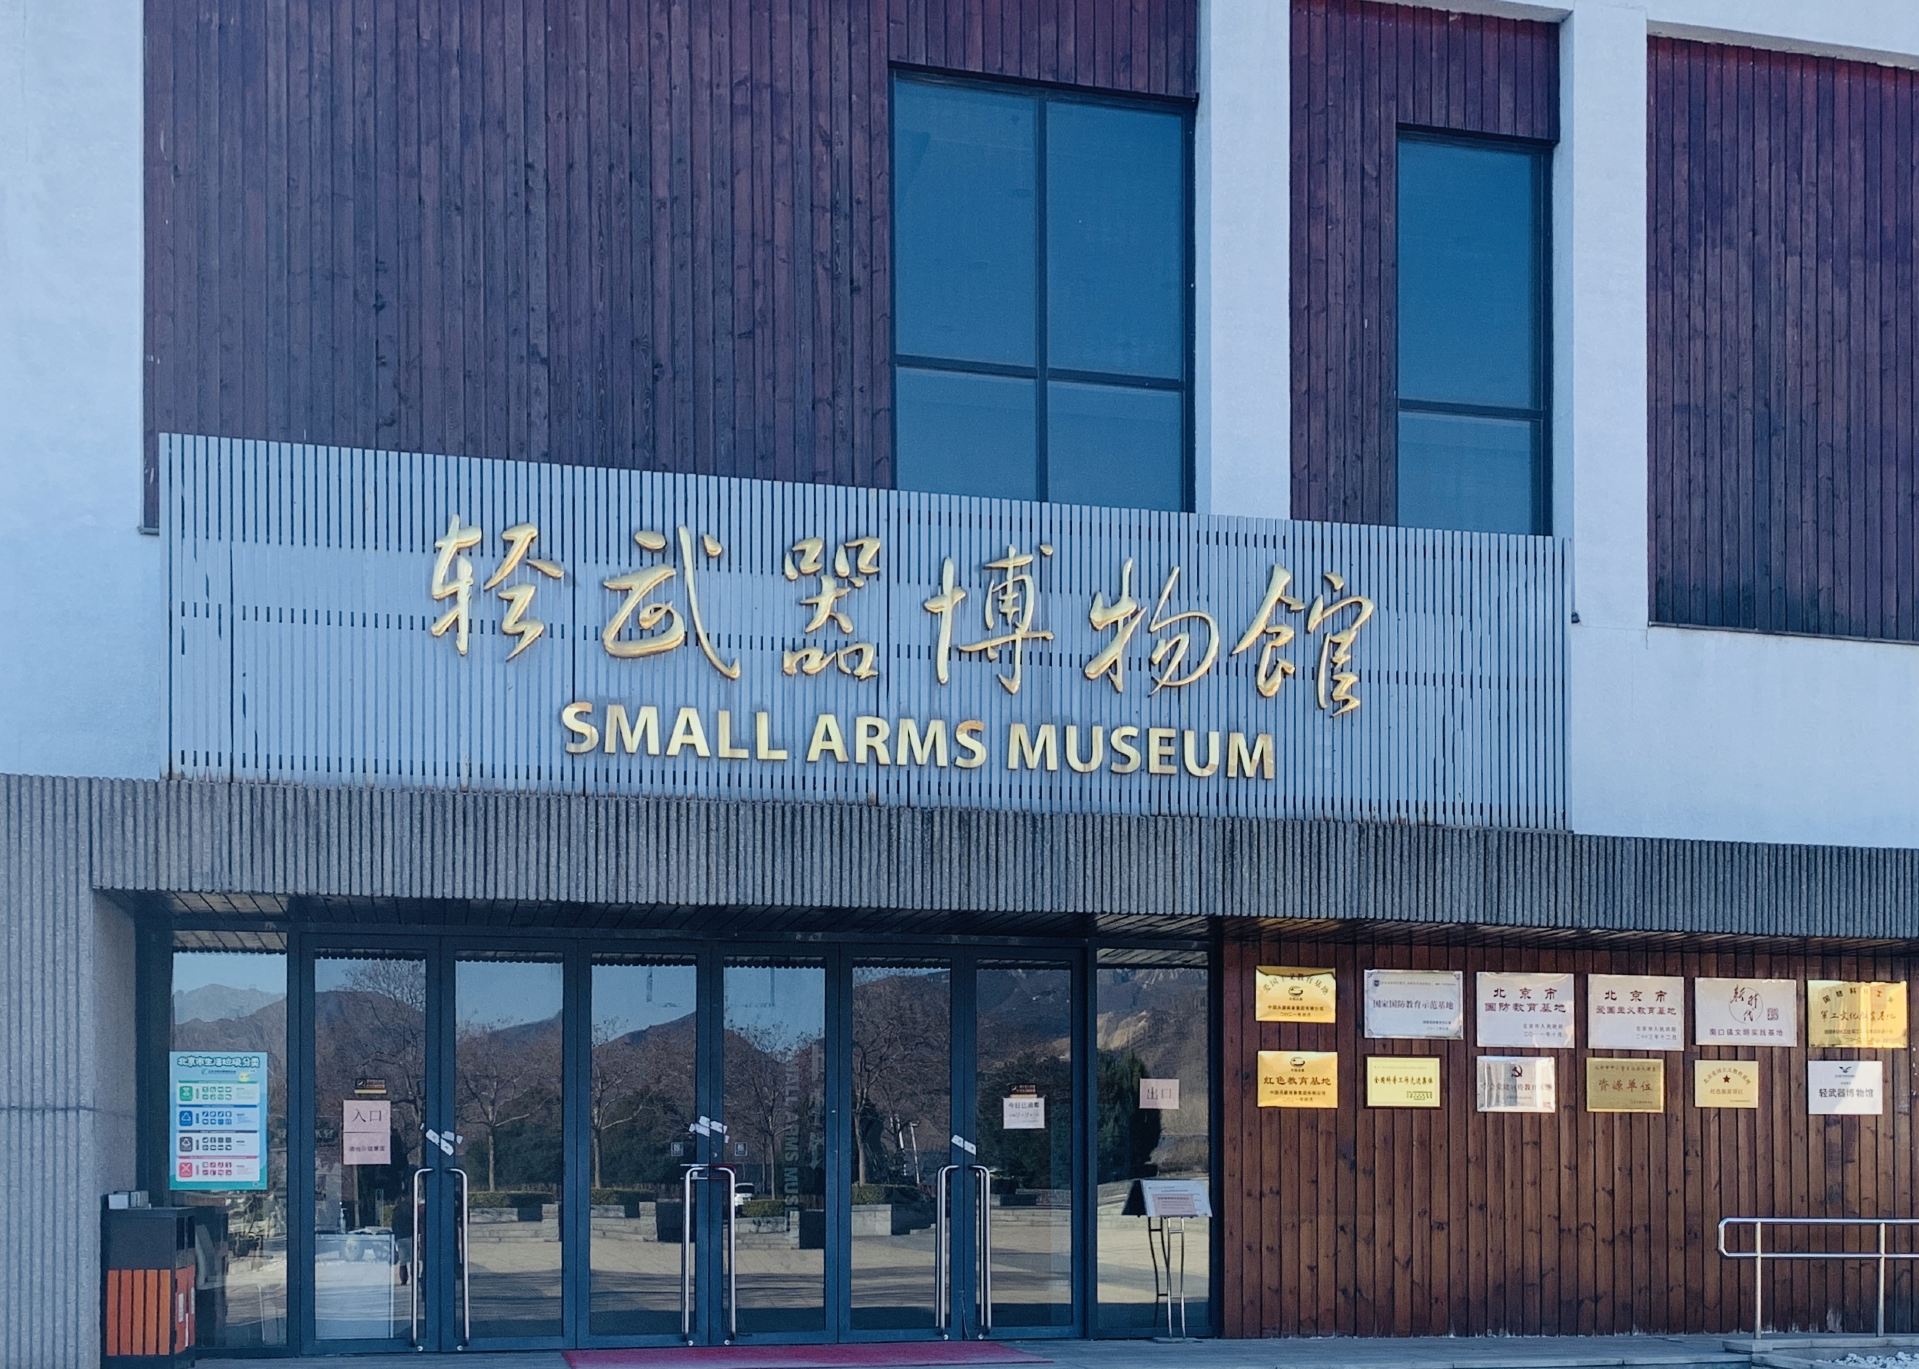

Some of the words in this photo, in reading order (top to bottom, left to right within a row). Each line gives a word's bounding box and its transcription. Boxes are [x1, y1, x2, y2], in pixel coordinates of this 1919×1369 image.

[430, 514, 1375, 717] 轻武器博物馆
[562, 701, 789, 761] SMALL
[806, 713, 987, 770] ARMS
[1007, 722, 1276, 780] MUSEUM
[1493, 987, 1558, 1000] 北京市
[1604, 989, 1668, 1003] 北京市
[1372, 999, 1454, 1010] 国家国防教育示范基地
[1484, 1002, 1567, 1014] 国防教育基地
[1596, 1005, 1677, 1016] 爱国主义教育基地
[1709, 1028, 1783, 1037] 南口镇文明实践基地
[176, 1055, 260, 1068] 北京市生活垃圾分类
[1263, 1075, 1332, 1086] 红色教育基地
[1598, 1078, 1653, 1093] 资源单位
[1146, 1086, 1173, 1101] 出口
[1819, 1088, 1874, 1098] 轻武器博物馆
[351, 1109, 383, 1123] 入口
